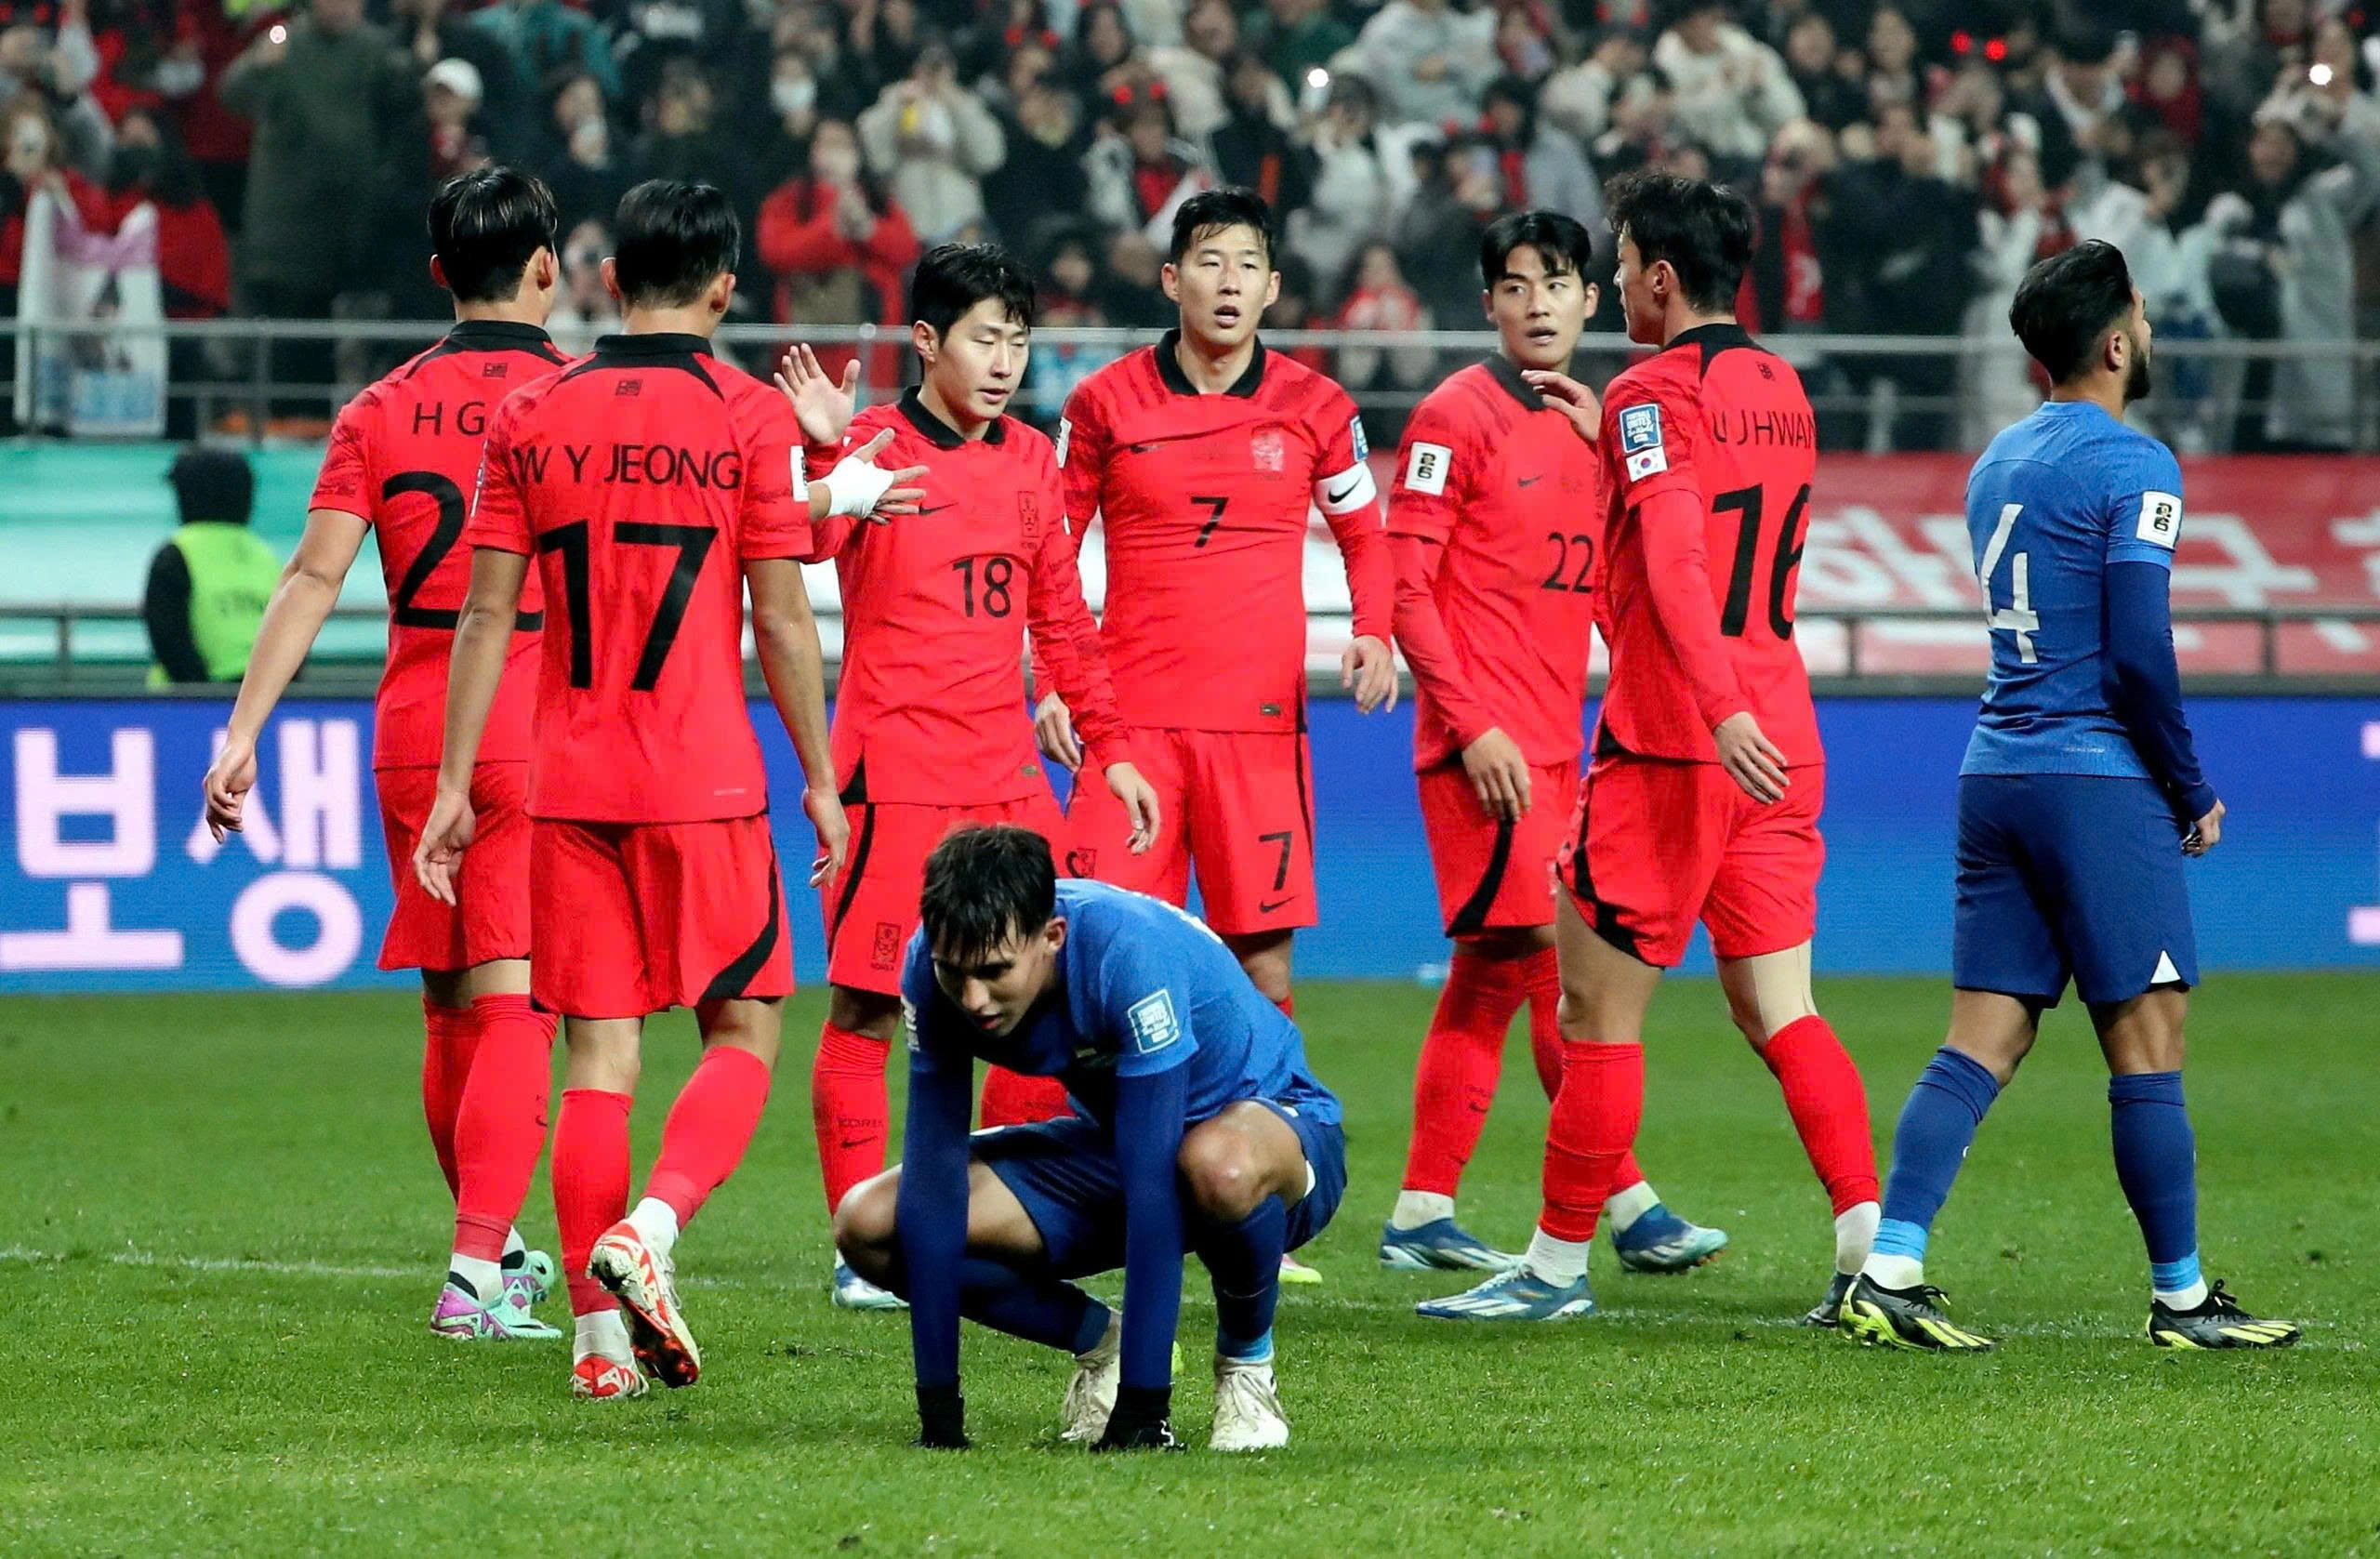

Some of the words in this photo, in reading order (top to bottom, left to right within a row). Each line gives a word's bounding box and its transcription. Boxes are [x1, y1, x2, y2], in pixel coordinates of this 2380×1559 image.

[413, 402, 443, 435] H
[456, 402, 485, 436] G
[510, 445, 553, 484] W
[563, 444, 593, 483] Y
[603, 443, 742, 490] JEONG
[1190, 495, 1229, 548] 7
[952, 557, 1012, 618] 18
[1540, 532, 1593, 593] 22
[1981, 503, 2040, 664] 4
[536, 518, 720, 692] 17
[0, 720, 364, 988] 보생
[1258, 830, 1292, 892] 7
